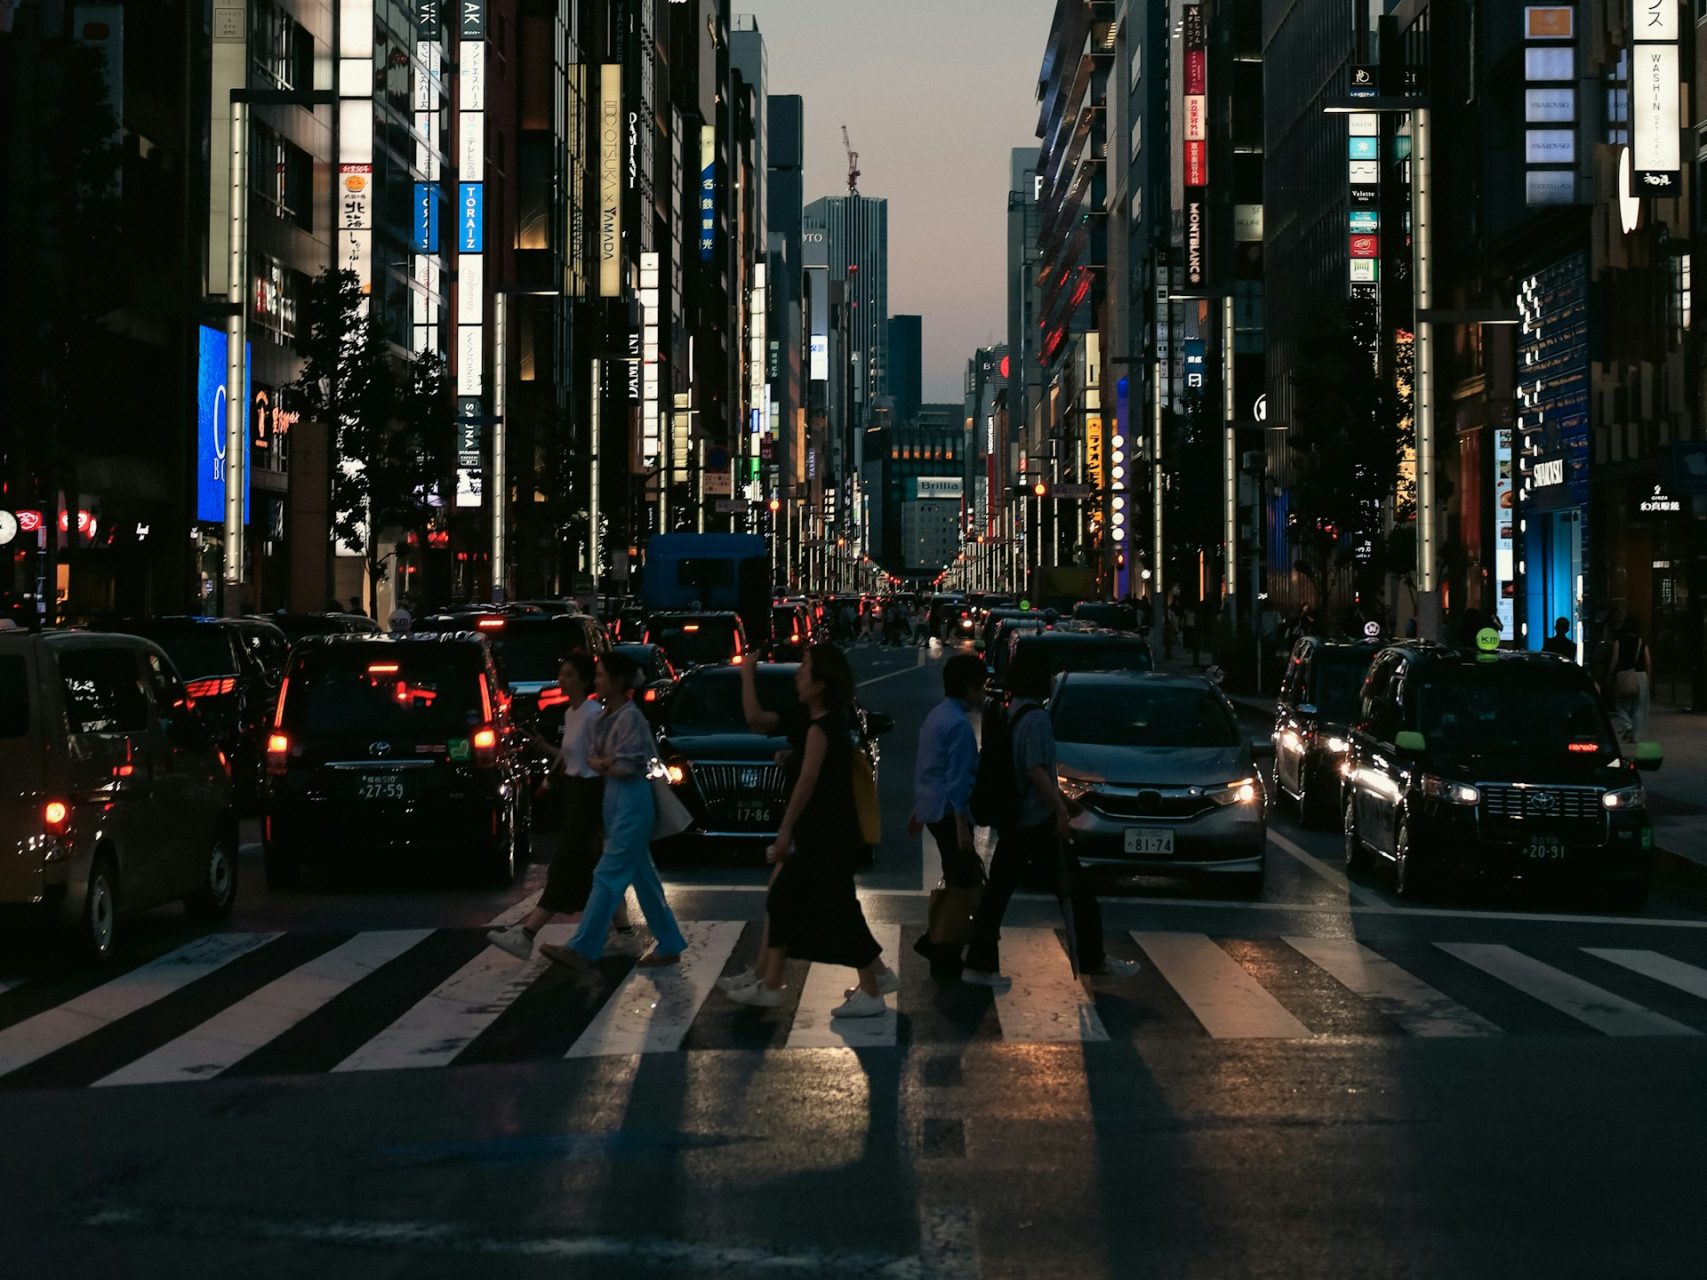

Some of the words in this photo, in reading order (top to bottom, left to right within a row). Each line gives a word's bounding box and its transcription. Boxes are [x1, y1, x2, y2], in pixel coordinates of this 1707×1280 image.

[464, 2, 480, 24] AK
[1651, 54, 1661, 111] WASHIN
[604, 130, 617, 190] OTSUKA
[629, 112, 637, 188] DAMIANI
[466, 187, 476, 248] TORAIZ
[604, 206, 617, 261] YAMADA
[1189, 202, 1200, 273] MONTBLANC
[921, 481, 958, 490] Brillia
[1533, 459, 1563, 487] SWAROVSKI
